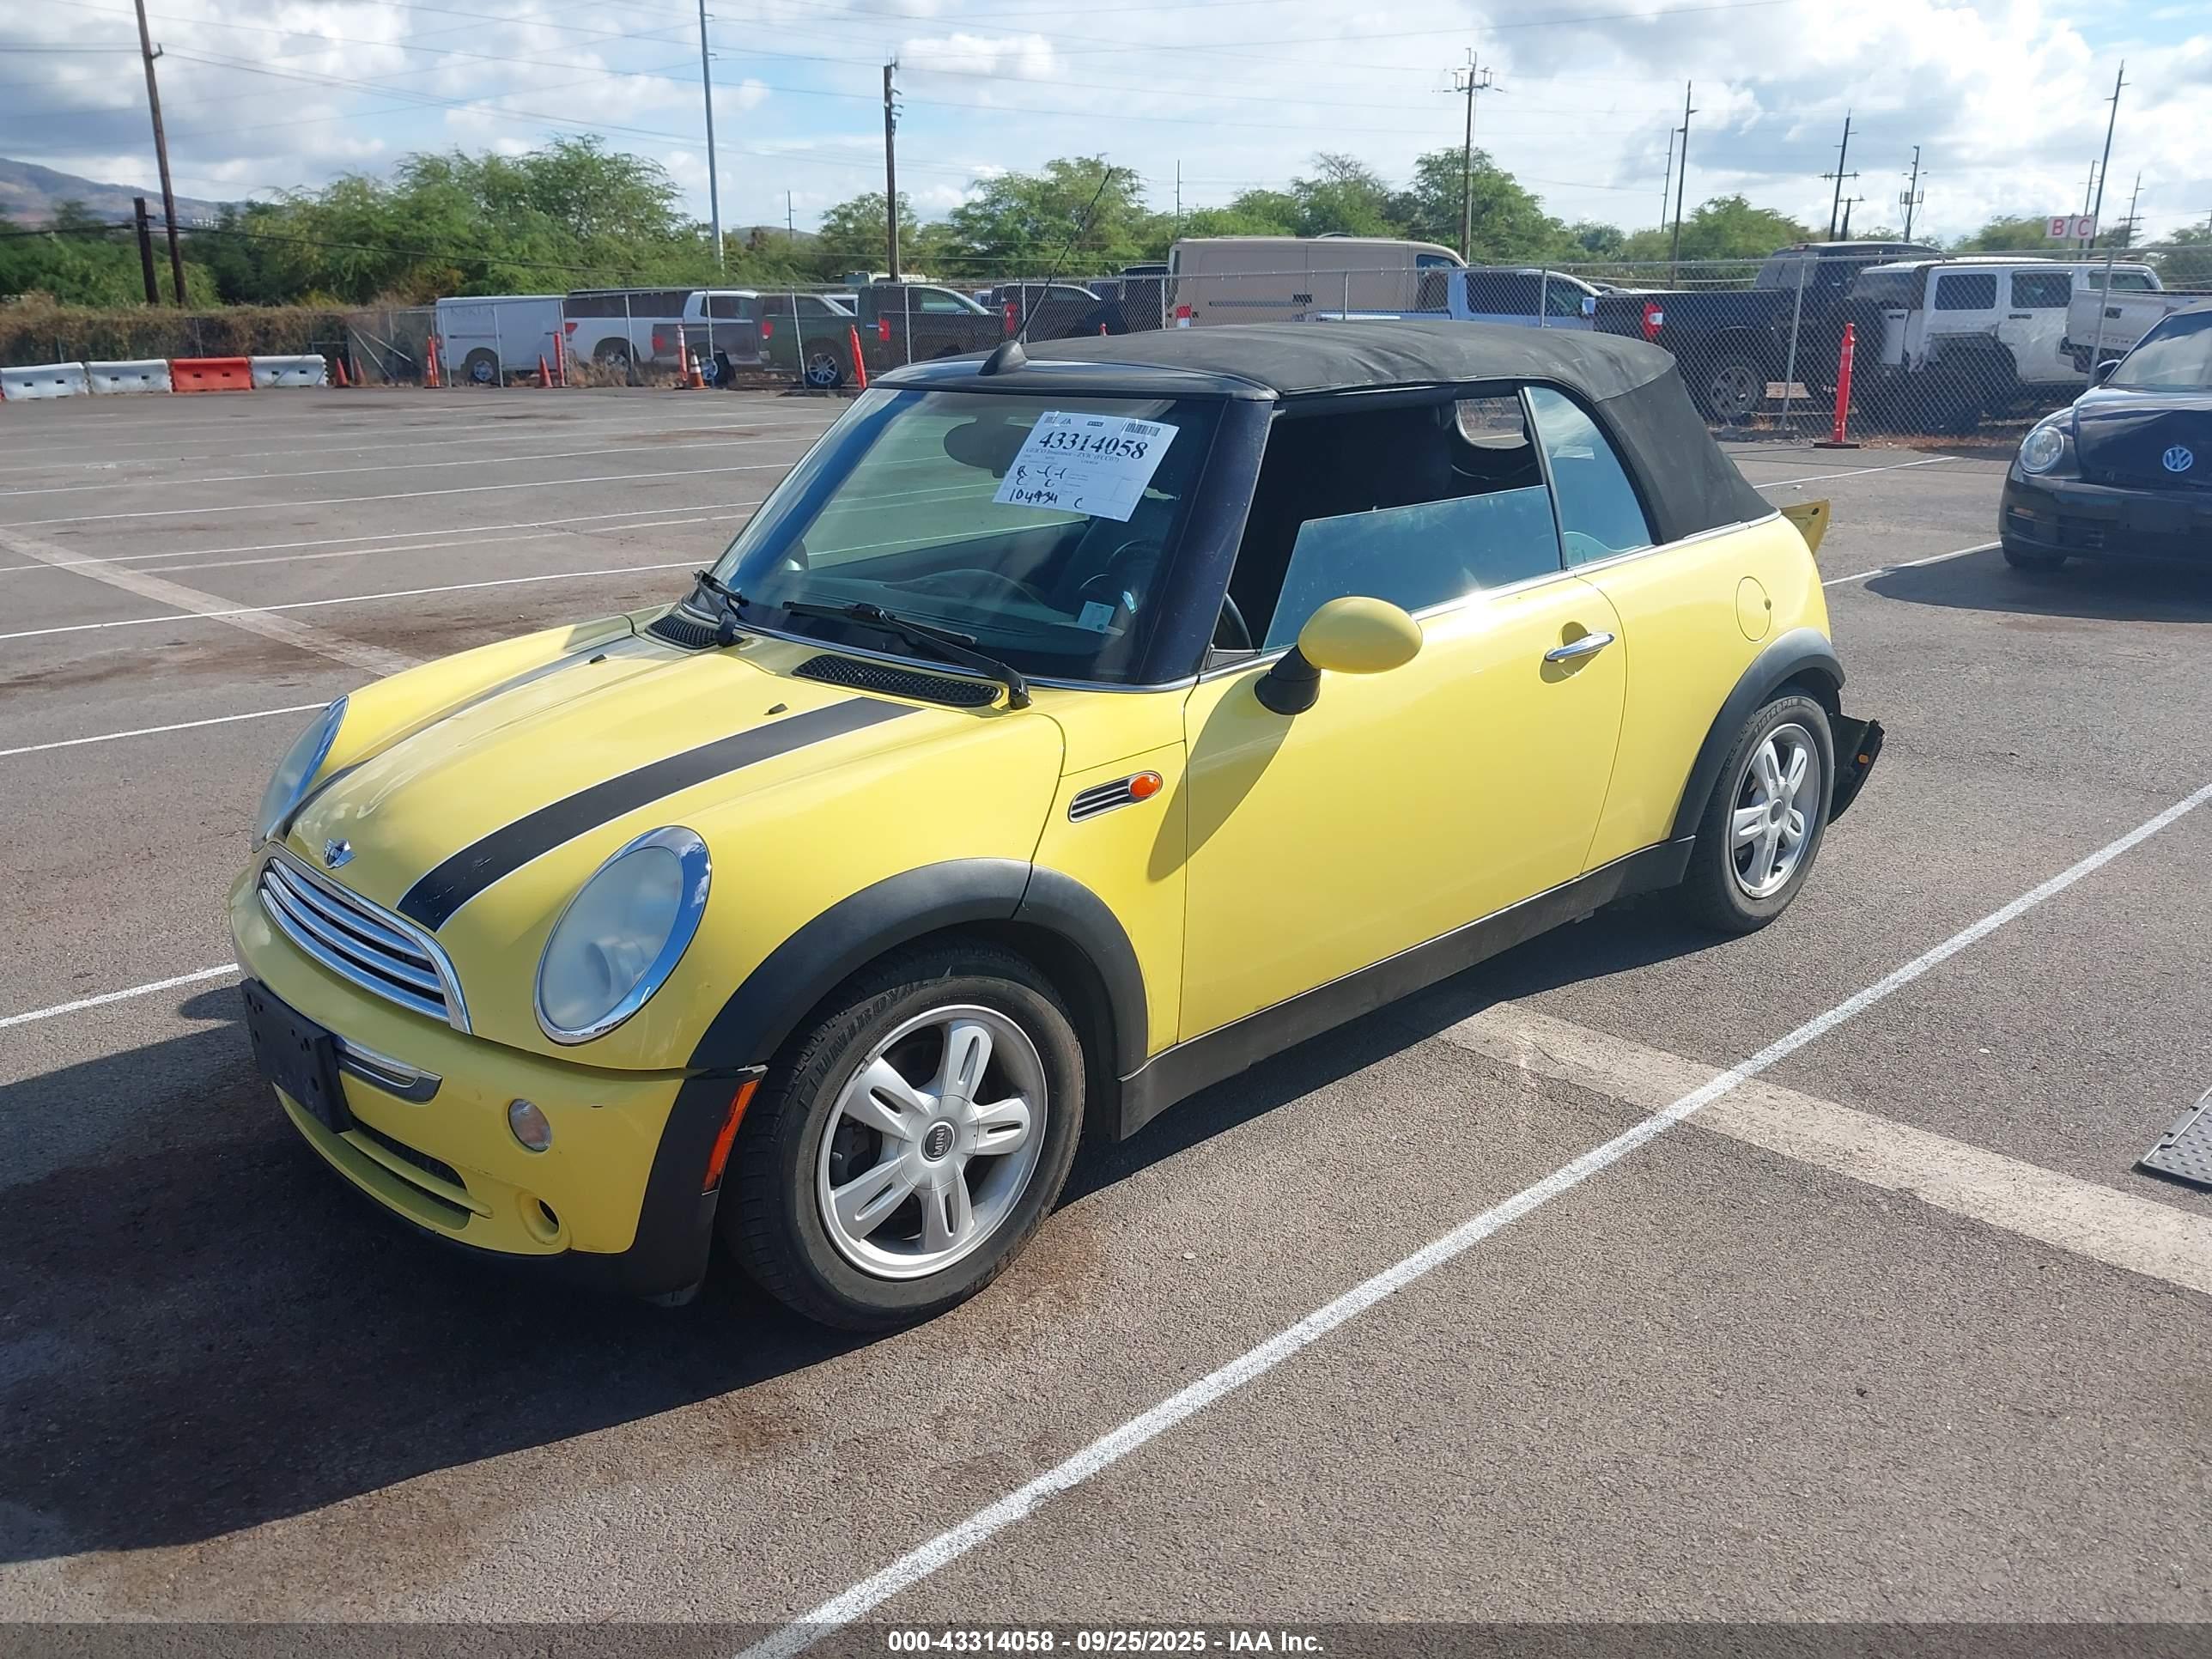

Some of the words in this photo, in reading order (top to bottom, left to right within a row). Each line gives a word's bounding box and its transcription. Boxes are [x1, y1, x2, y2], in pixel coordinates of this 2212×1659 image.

[2051, 219, 2064, 236] B
[2078, 219, 2090, 236] C
[1038, 431, 1149, 459] 43314058
[933, 1128, 945, 1156] MINI
